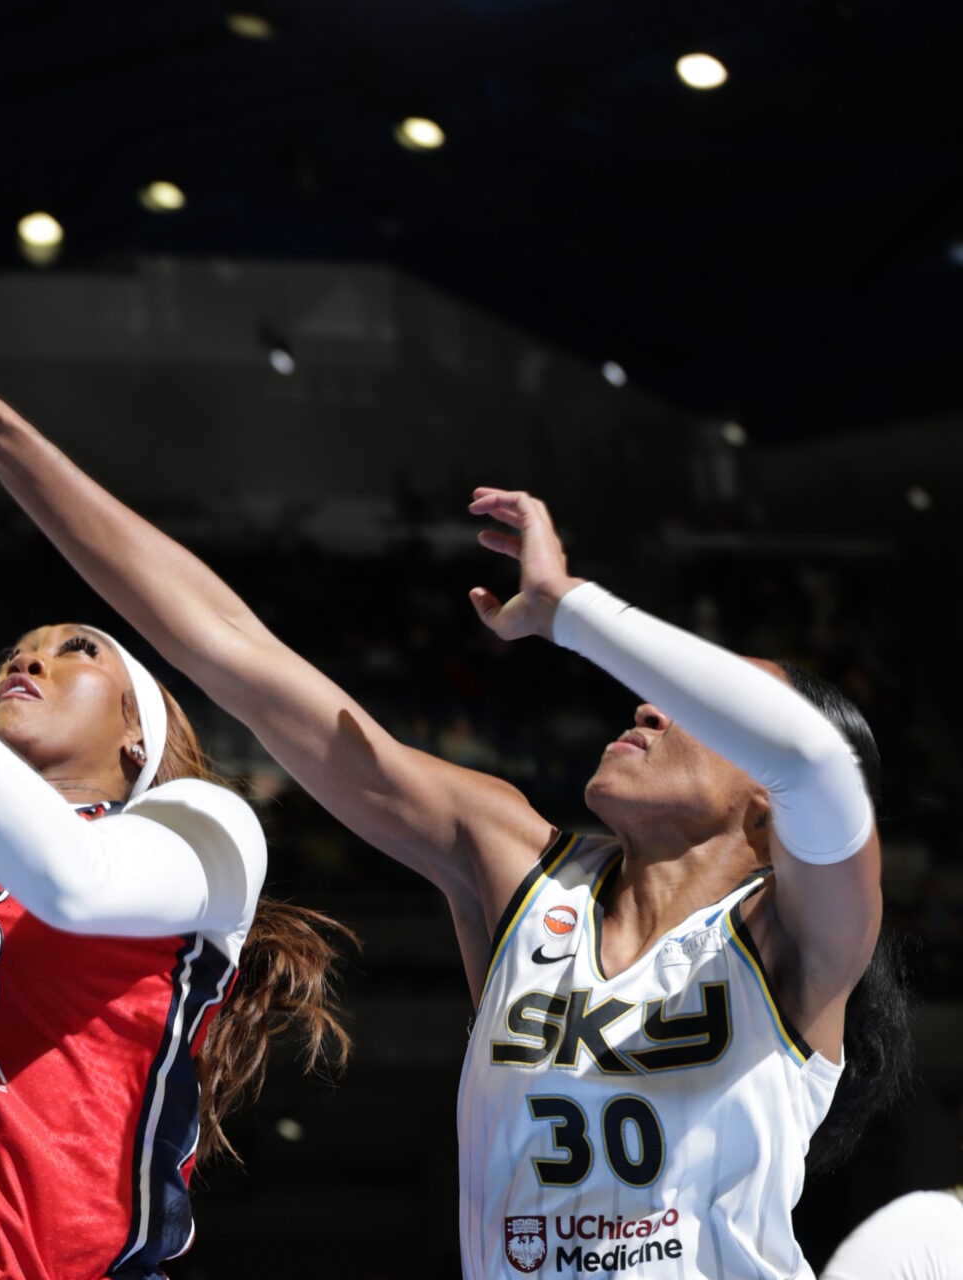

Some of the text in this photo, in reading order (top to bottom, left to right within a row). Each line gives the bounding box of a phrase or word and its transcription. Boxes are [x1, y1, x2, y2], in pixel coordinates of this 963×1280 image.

[489, 979, 735, 1076] SKY
[525, 1092, 666, 1189] 30
[555, 1208, 679, 1241] UChicao
[555, 1238, 683, 1273] Medicine
